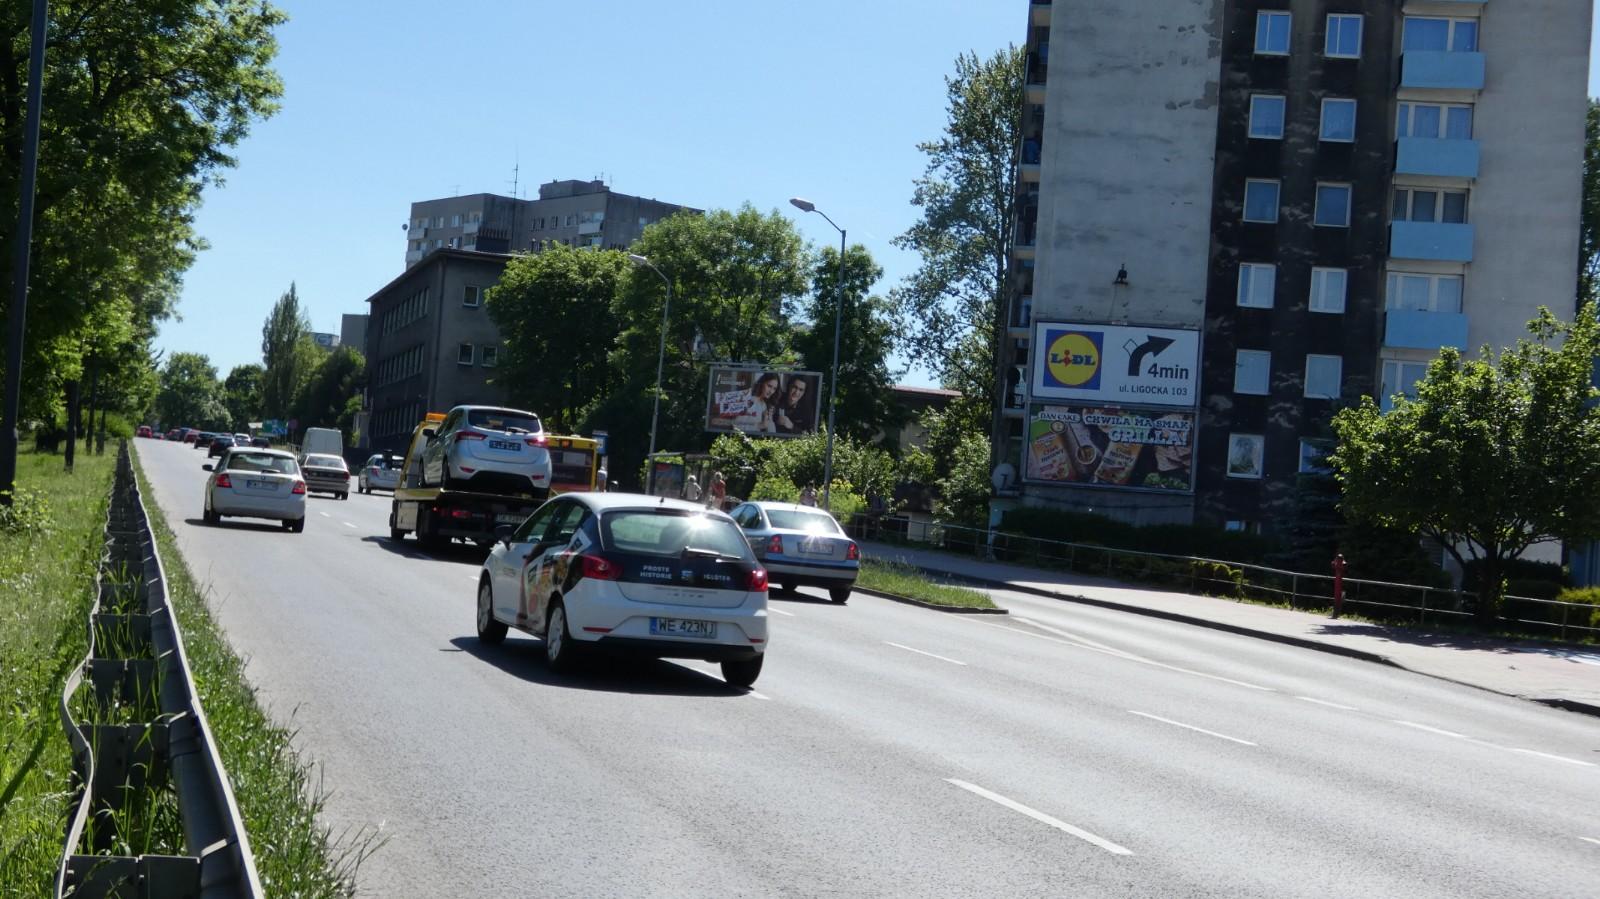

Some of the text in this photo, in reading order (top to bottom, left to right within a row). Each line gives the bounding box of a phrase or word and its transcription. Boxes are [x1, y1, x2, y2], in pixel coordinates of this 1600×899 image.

[1147, 363, 1189, 380] 4min
[1119, 384, 1129, 392] ul.
[1171, 387, 1188, 396] 103
[1085, 415, 1132, 426] CHWILA
[1155, 420, 1189, 429] SMAK
[640, 571, 672, 579] HISTORIE
[658, 617, 675, 632] WE
